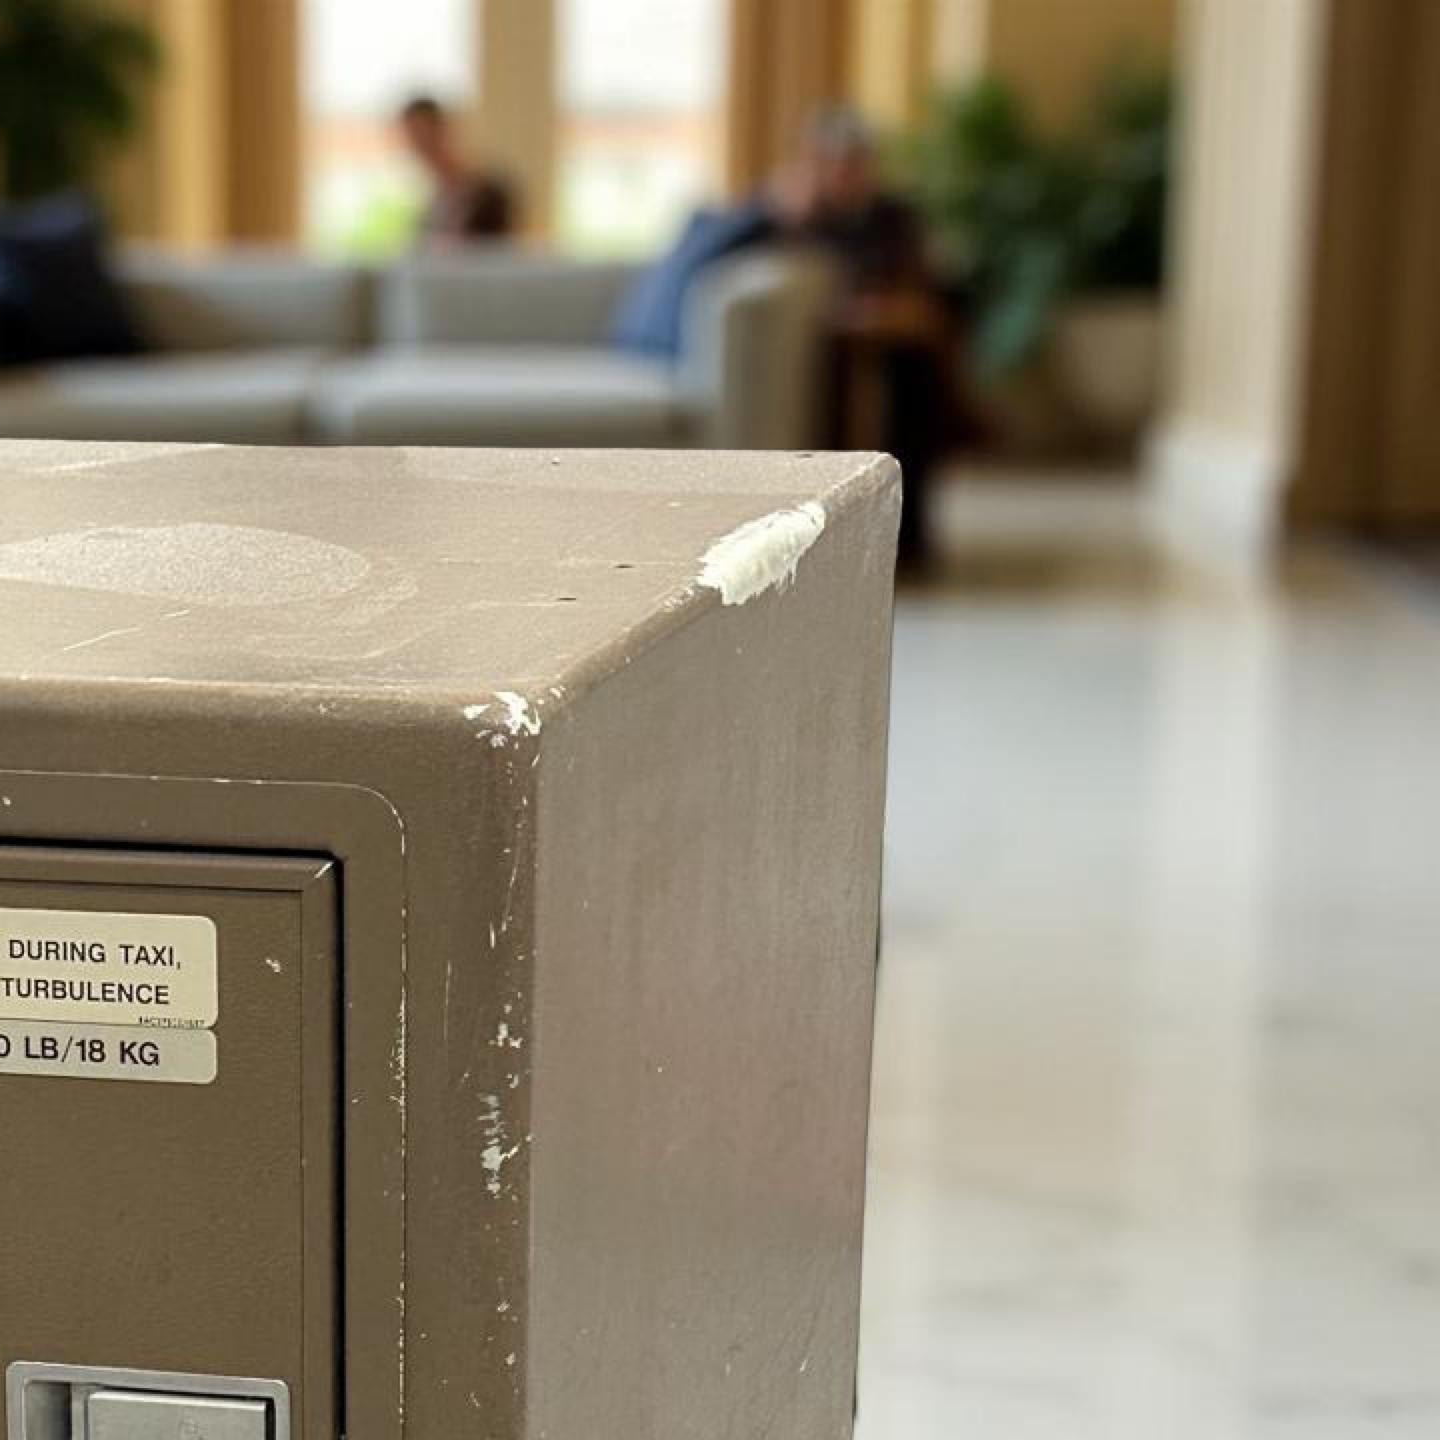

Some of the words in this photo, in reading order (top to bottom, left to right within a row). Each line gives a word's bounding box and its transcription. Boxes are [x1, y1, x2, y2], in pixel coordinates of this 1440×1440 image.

[8, 939, 107, 964] DURING
[118, 943, 181, 970] TAXI,
[1, 977, 170, 1005] TURBULENCE
[23, 1035, 107, 1064] LB/18
[119, 1039, 161, 1067] KG
